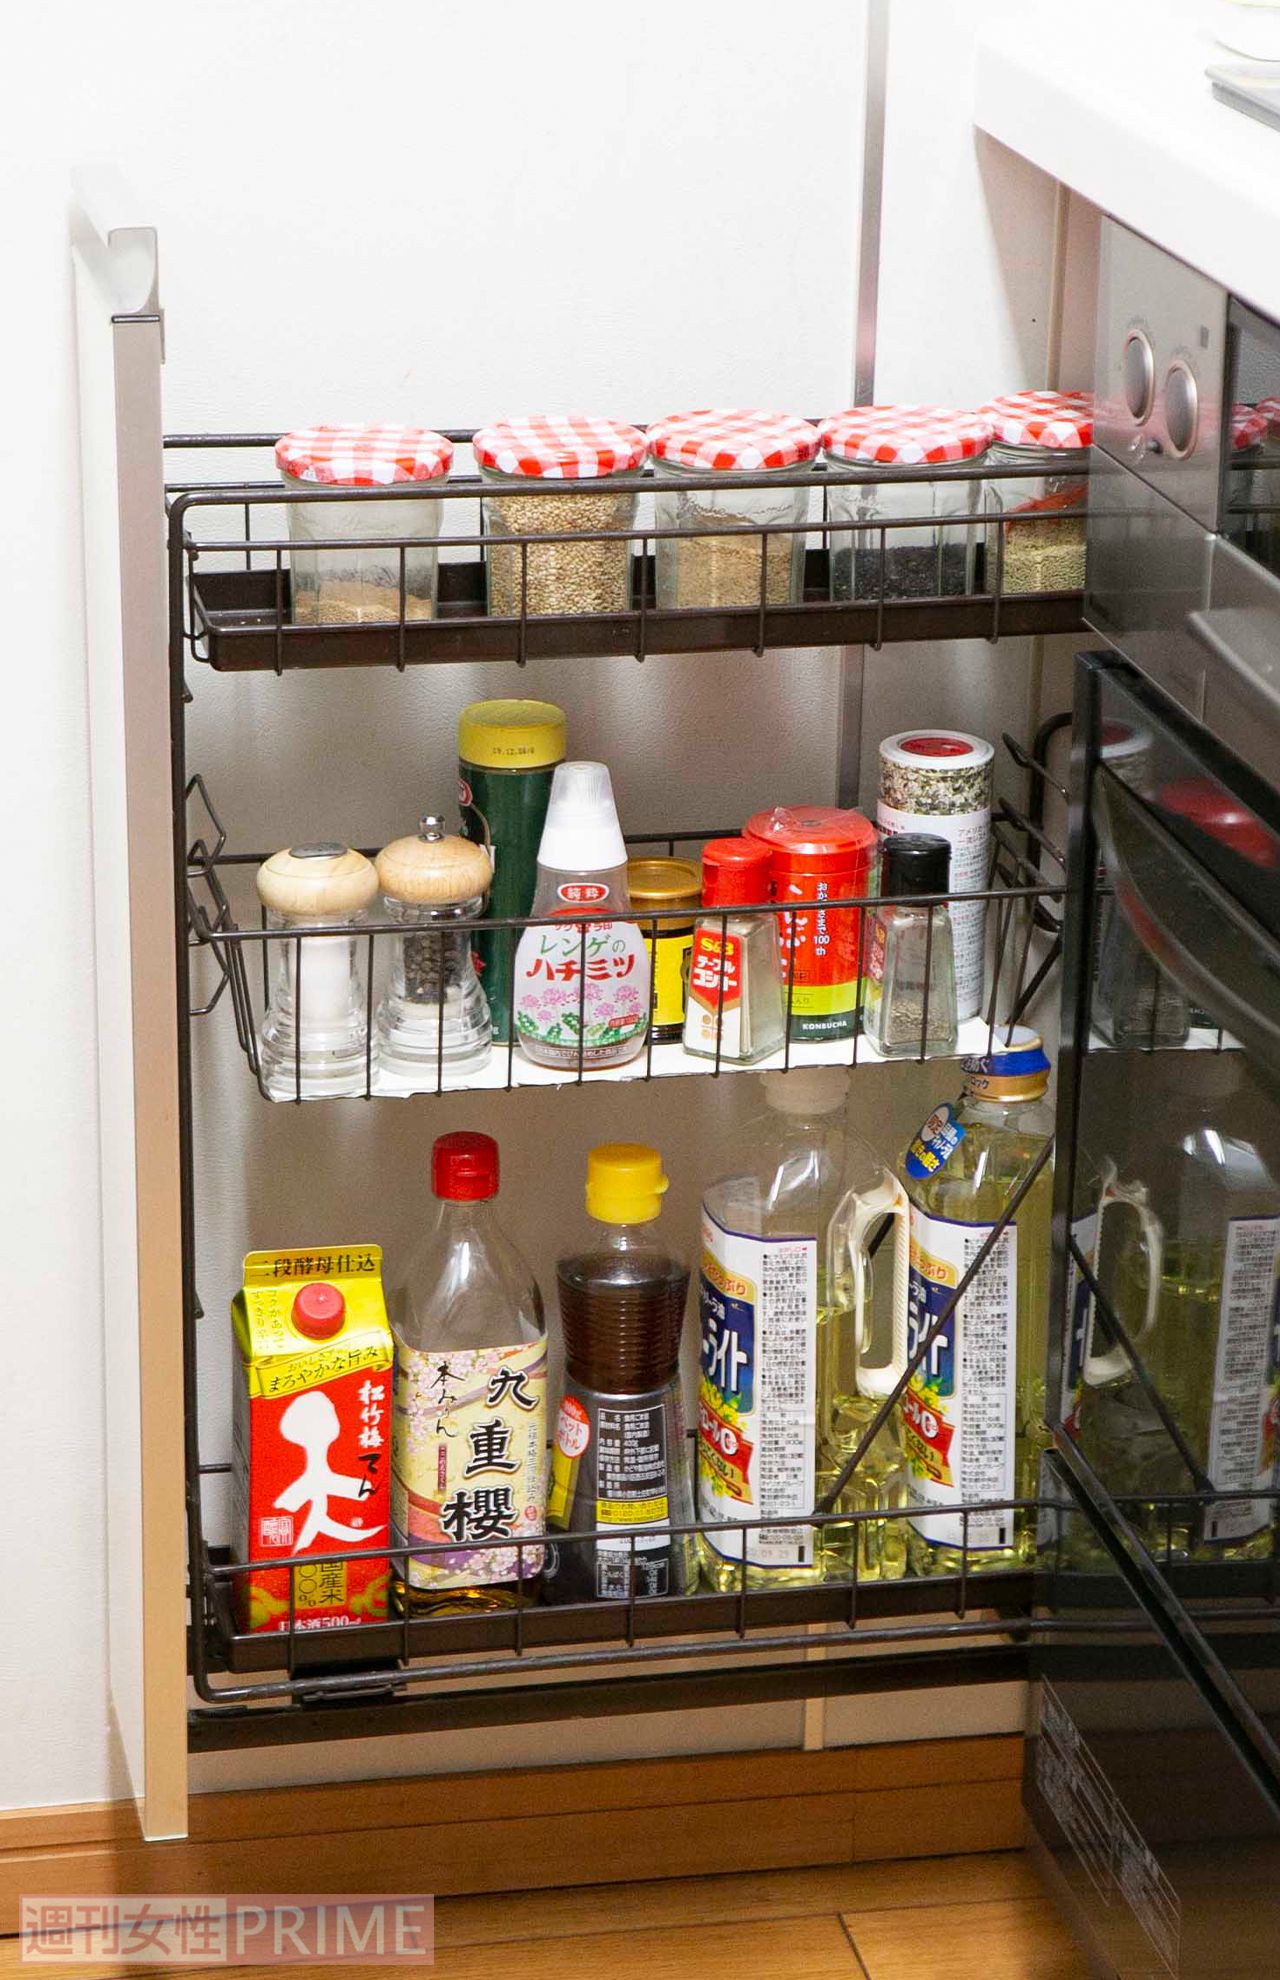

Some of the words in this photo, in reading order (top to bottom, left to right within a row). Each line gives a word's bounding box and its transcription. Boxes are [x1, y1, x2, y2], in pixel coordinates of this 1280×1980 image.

[540, 934, 627, 958] レンゲの
[525, 954, 635, 982] ハチミツ
[802, 1020, 848, 1031] KONBUCHA
[252, 1253, 376, 1278] 二段酵母仕込
[269, 1345, 379, 1393] まろやかな旨み
[430, 1360, 467, 1438] 本みりん
[357, 1379, 386, 1449] 松竹梅
